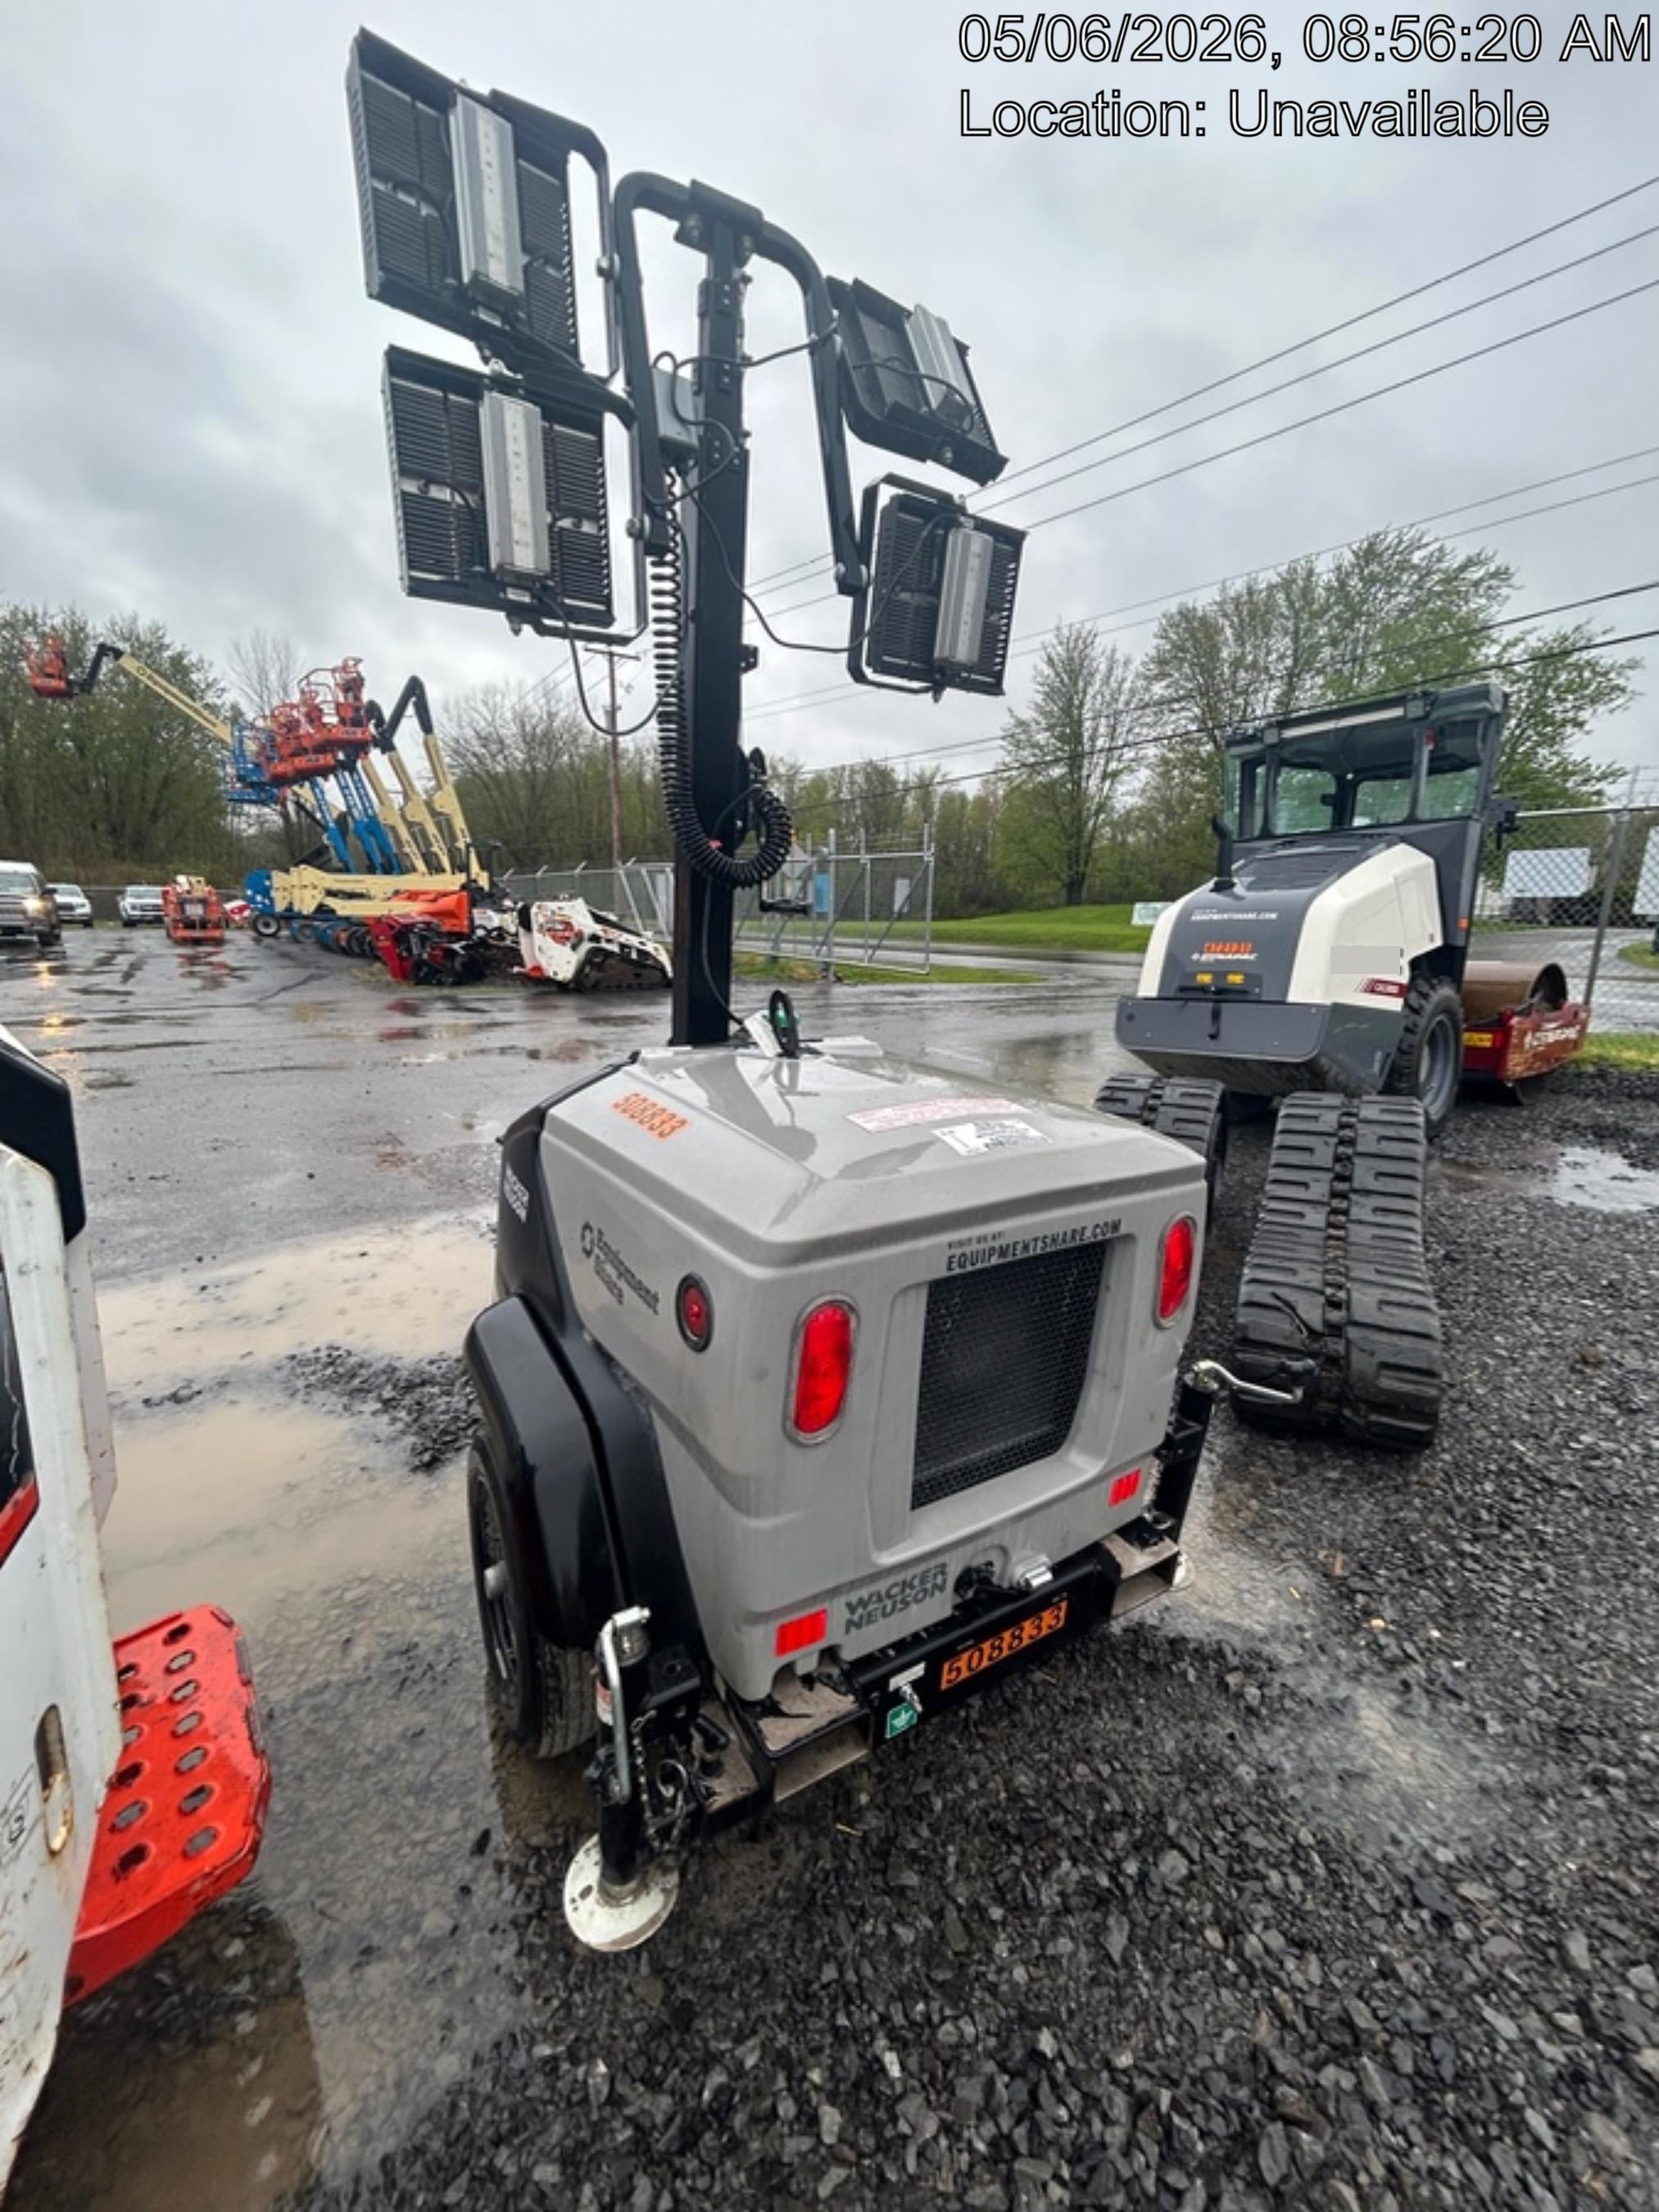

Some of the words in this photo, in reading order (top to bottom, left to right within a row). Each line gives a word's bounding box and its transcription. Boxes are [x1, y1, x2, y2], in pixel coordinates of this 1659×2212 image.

[945, 1218, 1122, 1272] EQUIPMENTSHARE.COM
[844, 1572, 948, 1635] NEUSON
[845, 1562, 948, 1616] WACKER
[945, 1605, 1063, 1686] 508833
